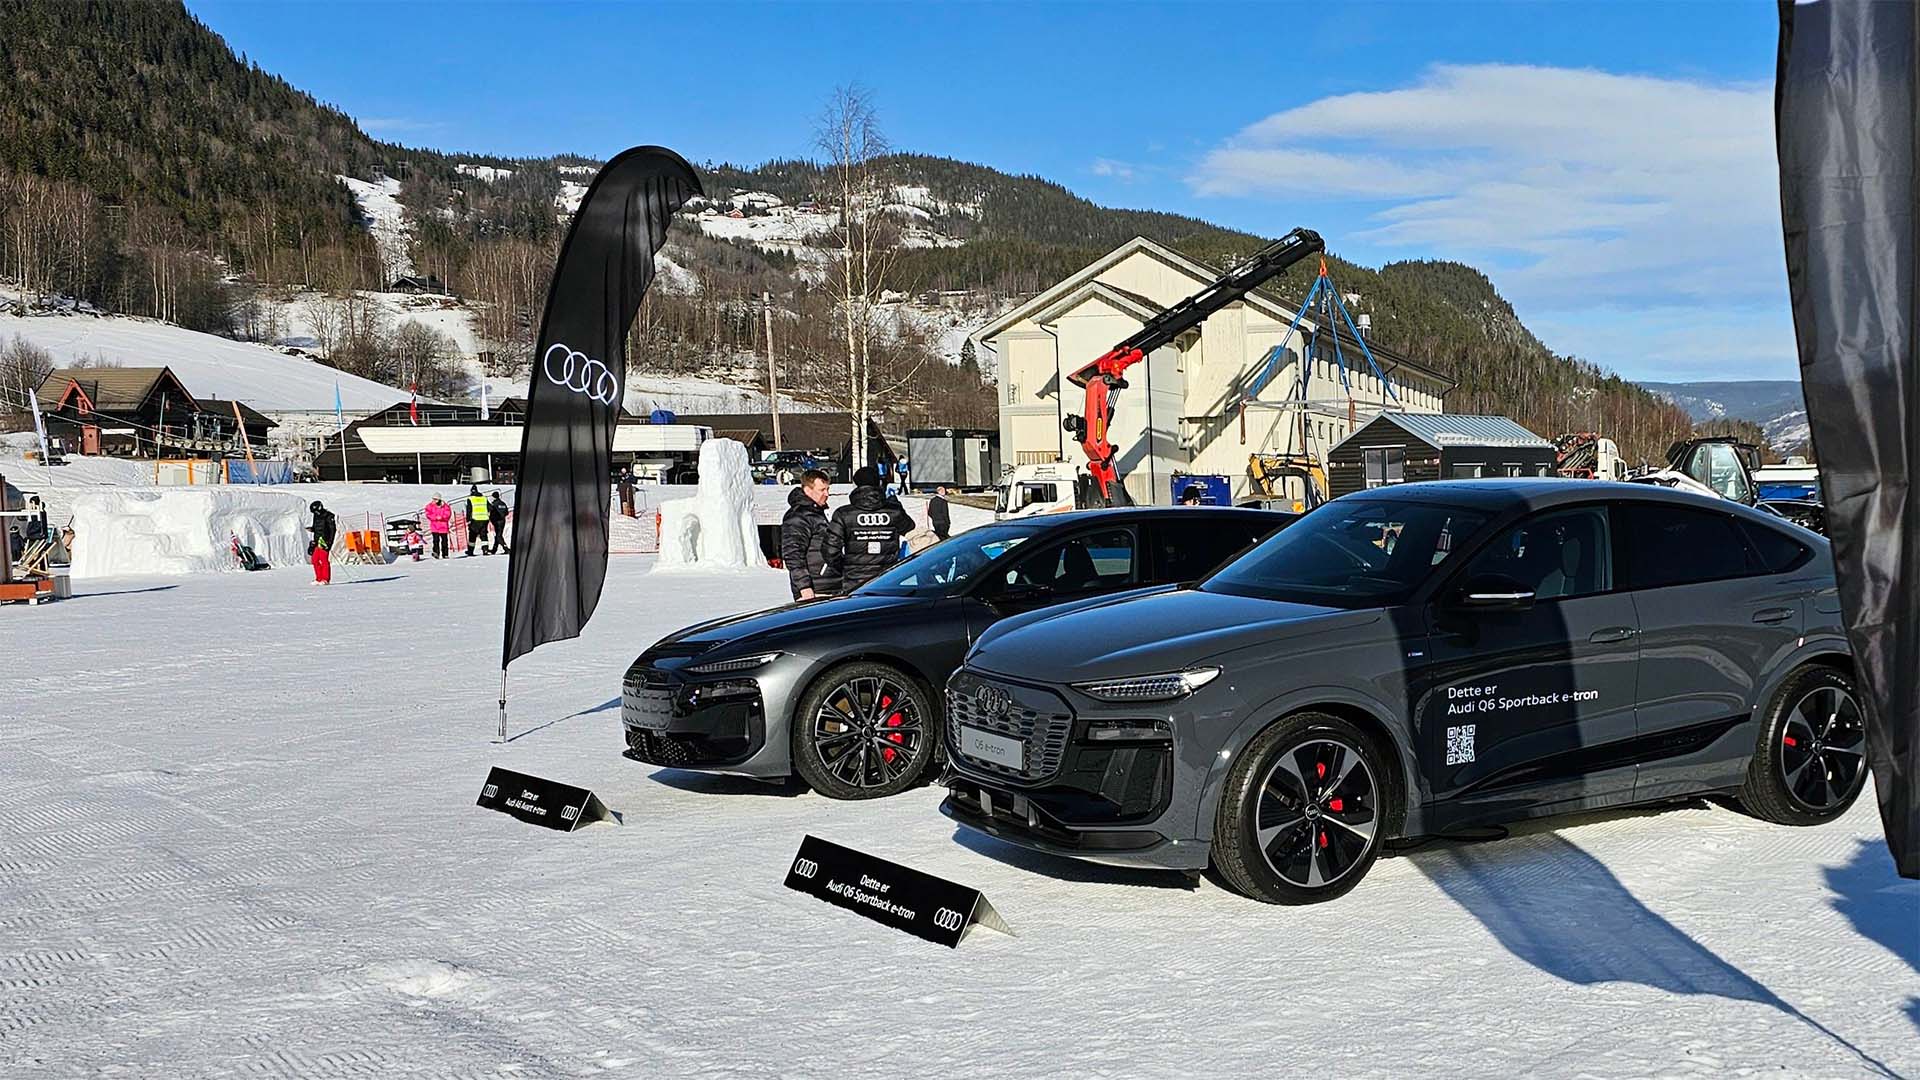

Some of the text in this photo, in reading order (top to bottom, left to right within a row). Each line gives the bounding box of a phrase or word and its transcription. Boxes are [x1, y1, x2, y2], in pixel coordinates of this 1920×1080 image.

[1448, 685, 1498, 699] Dette er
[1447, 690, 1599, 715] Audi Q6 Sportback e-tron
[985, 744, 1005, 756] e-tron
[521, 789, 533, 799] Dette
[505, 797, 515, 806] Audi
[521, 802, 533, 812] Avant
[533, 807, 547, 816] e-tron
[860, 874, 891, 893] Dette er
[826, 879, 916, 921] Audi Q6 Sportback e-tron
